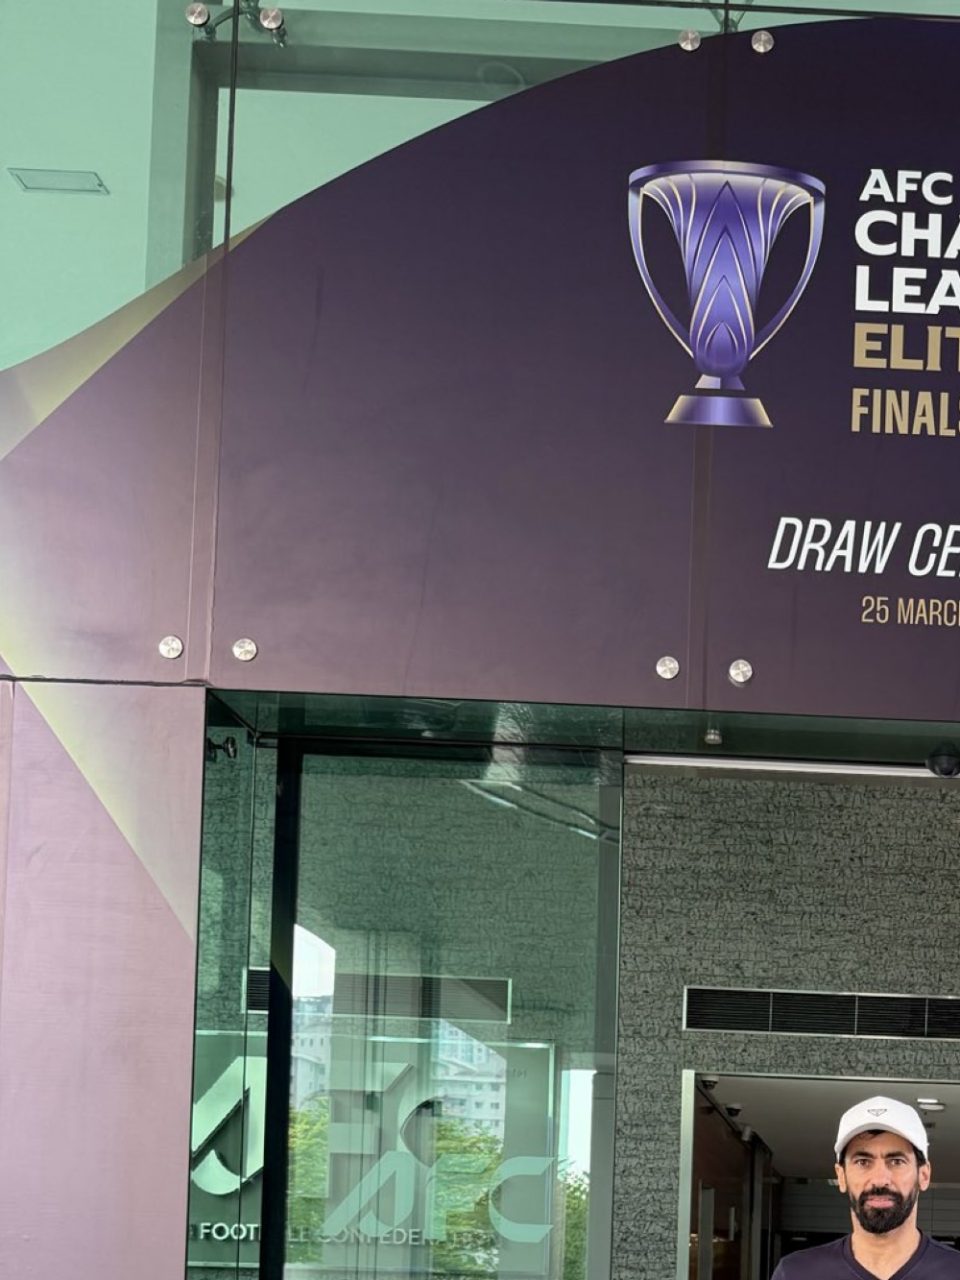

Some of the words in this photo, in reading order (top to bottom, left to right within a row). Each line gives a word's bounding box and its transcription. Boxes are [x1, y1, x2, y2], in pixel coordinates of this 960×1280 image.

[859, 168, 954, 206] AFC
[767, 516, 903, 575] DRAW
[861, 595, 890, 624] 25
